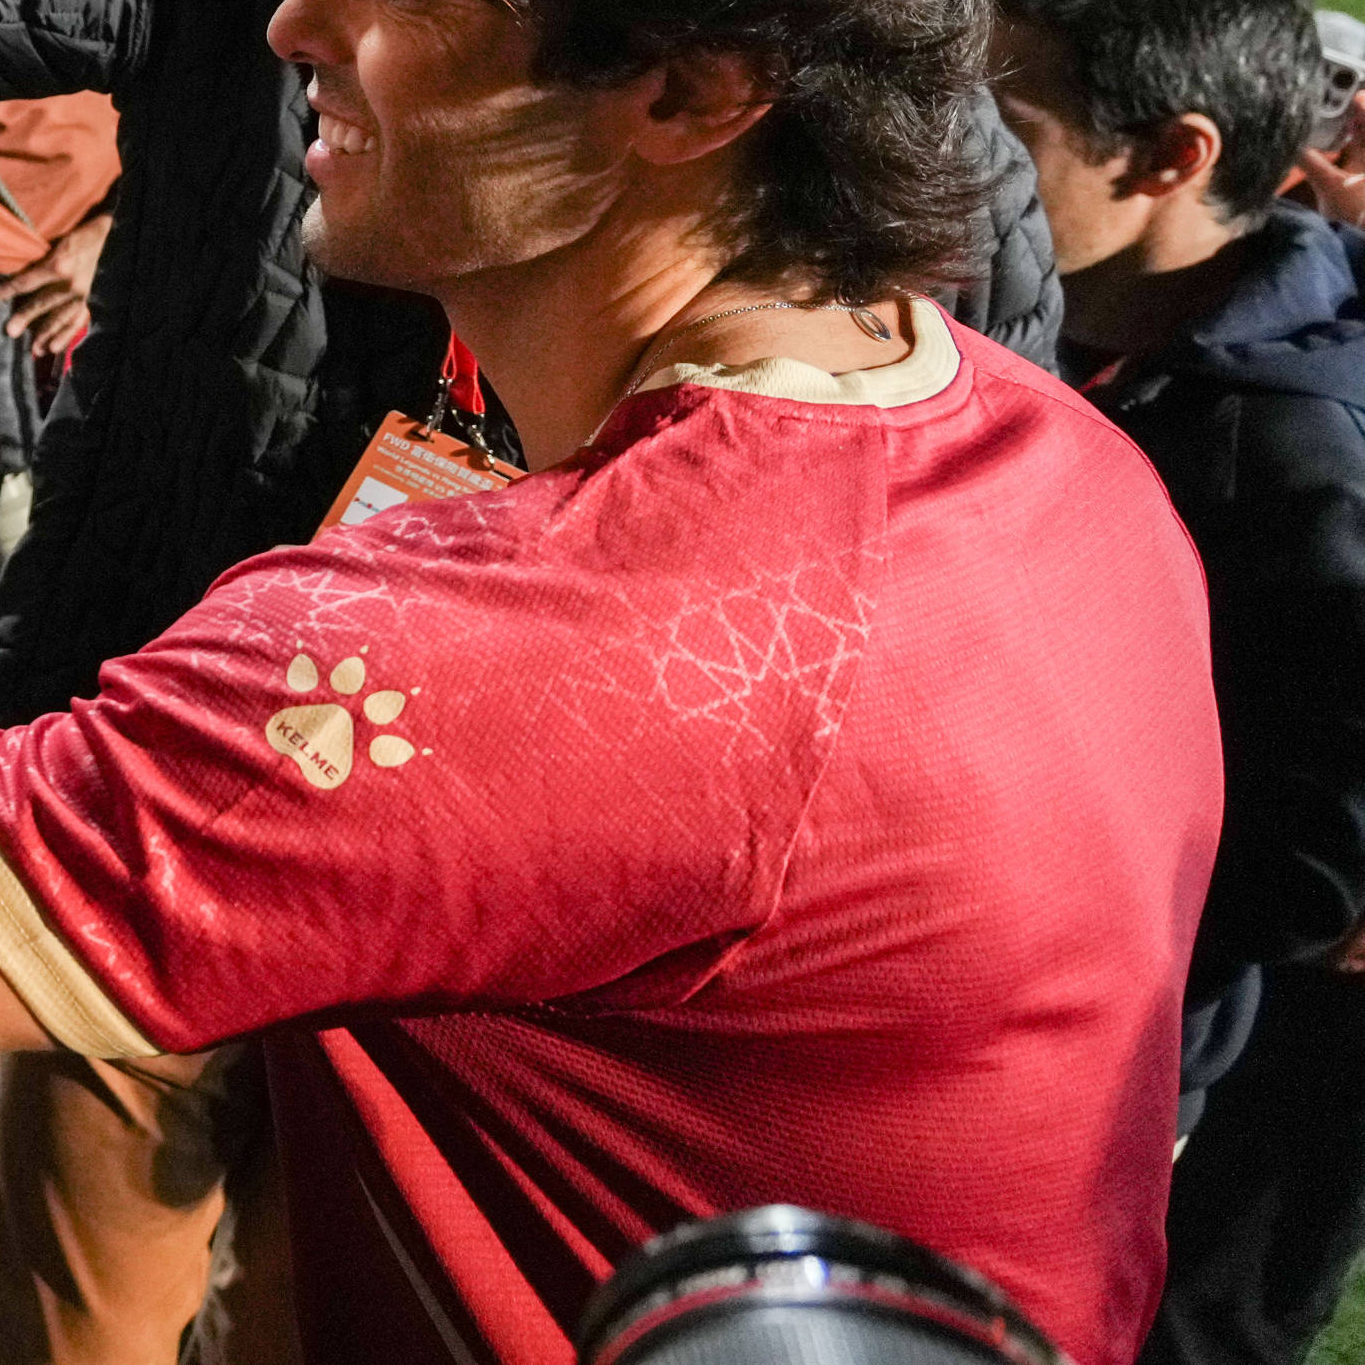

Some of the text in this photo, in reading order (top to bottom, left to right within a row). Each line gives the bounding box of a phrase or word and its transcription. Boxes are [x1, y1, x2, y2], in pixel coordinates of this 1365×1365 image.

[382, 432, 412, 452] FWD
[377, 445, 400, 461] World
[276, 721, 339, 780] KELME
